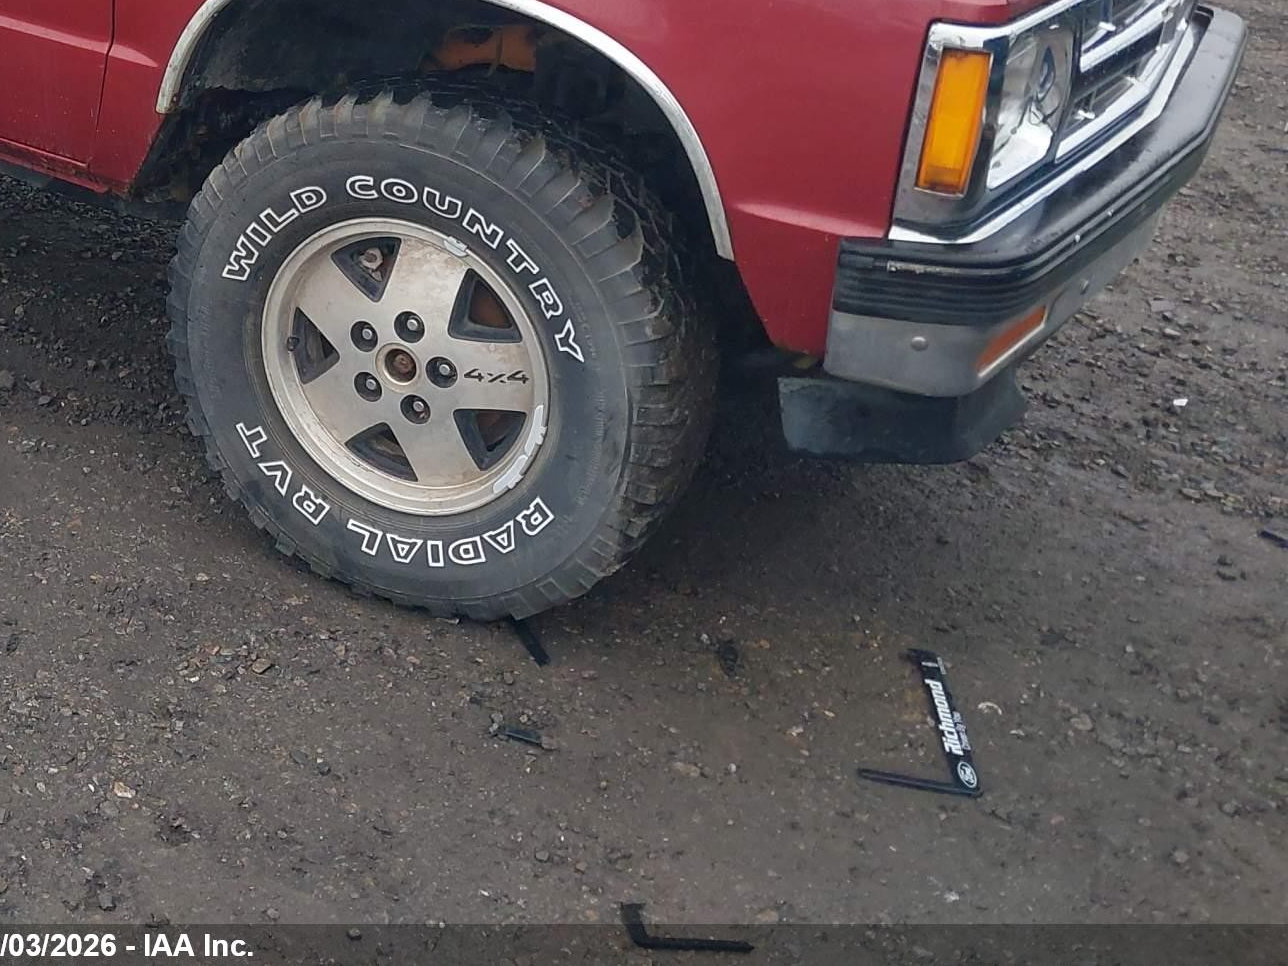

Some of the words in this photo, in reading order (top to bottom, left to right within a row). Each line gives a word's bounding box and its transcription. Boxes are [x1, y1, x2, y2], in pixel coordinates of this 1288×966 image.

[222, 185, 328, 282] WILD
[345, 175, 585, 364] COUNTRY
[463, 368, 530, 385] 4x4
[235, 422, 331, 525] RVT
[346, 497, 555, 568] RADIAL
[924, 678, 964, 756] Richmond
